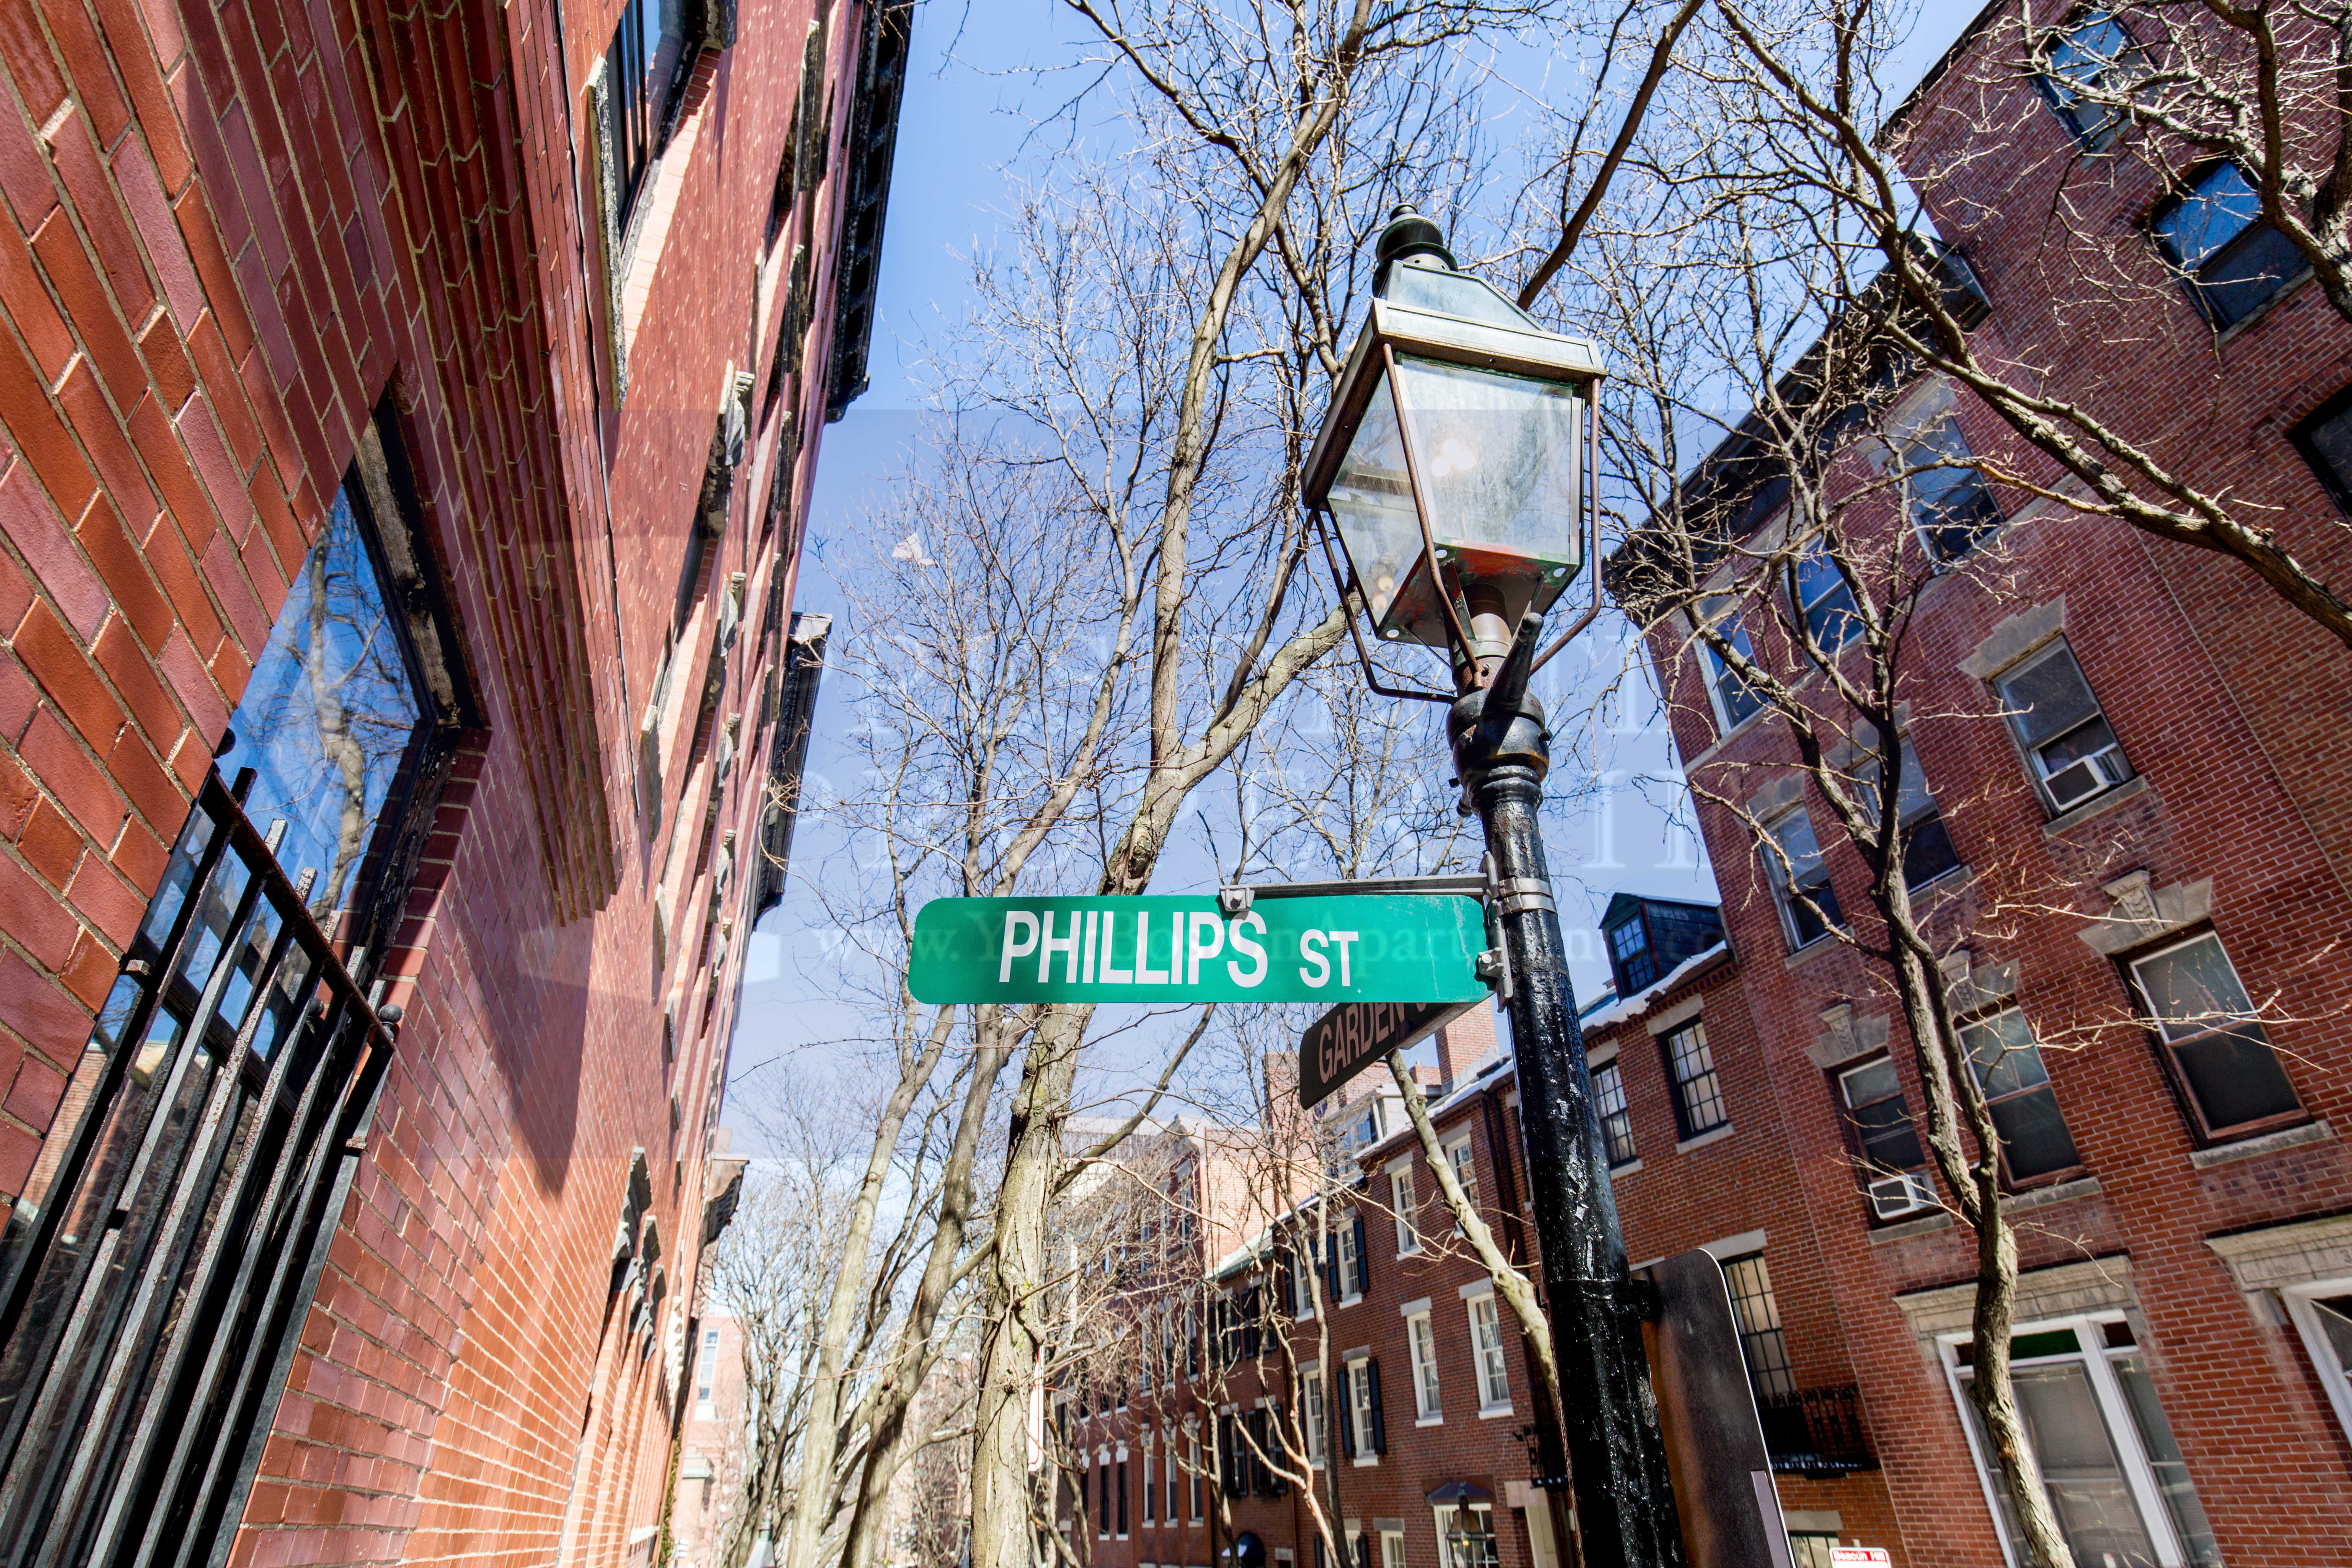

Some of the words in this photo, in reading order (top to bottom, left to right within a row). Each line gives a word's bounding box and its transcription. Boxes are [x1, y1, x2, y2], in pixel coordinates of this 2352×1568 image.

[999, 910, 1268, 988] PHILLIPS
[1299, 929, 1359, 988] ST
[1833, 1550, 1868, 1561] Beacon
[1870, 1551, 1886, 1561] Hill
